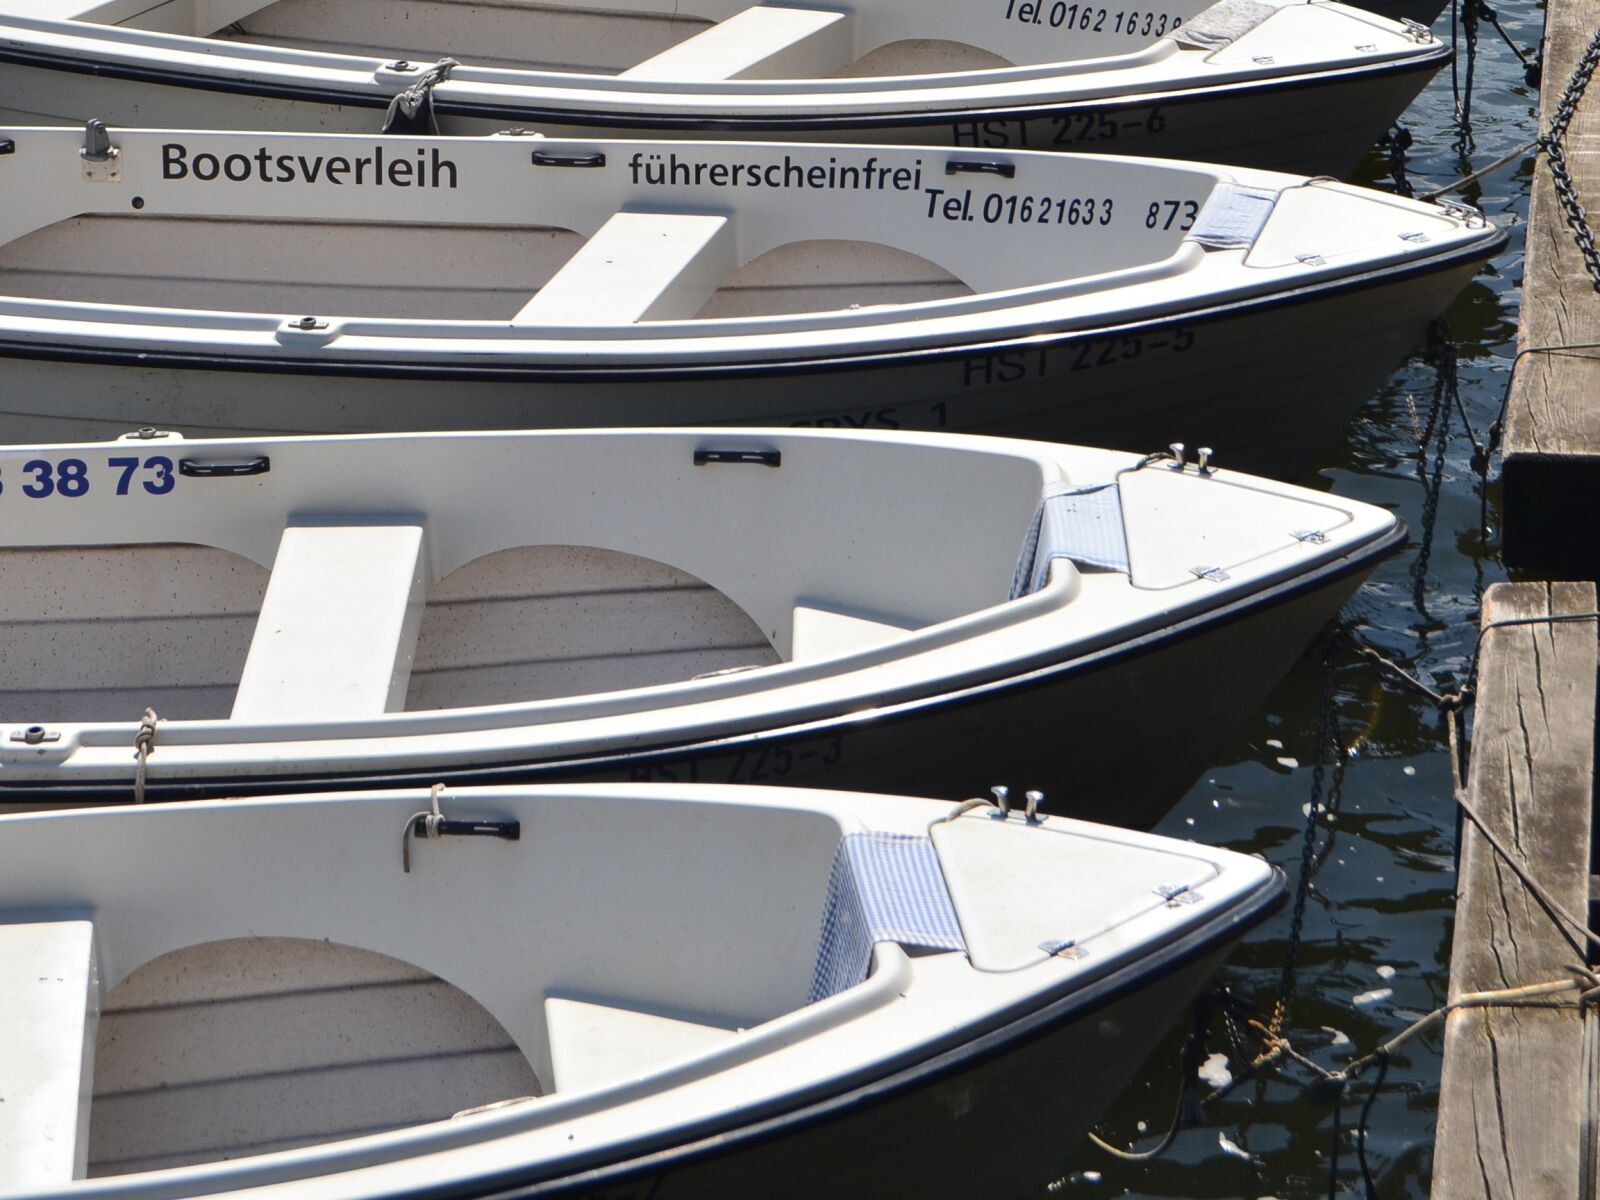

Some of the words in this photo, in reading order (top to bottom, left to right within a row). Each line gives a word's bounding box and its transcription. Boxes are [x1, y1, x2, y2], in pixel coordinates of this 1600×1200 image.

[952, 119, 1033, 148] HST
[1052, 106, 1167, 145] 225-6
[161, 142, 458, 189] Bootsverleih
[628, 152, 922, 191] führerscheinfrei
[924, 188, 974, 222] Tel.
[1145, 199, 1199, 232] 873
[964, 351, 1047, 386] HST
[1069, 327, 1195, 373] 225-5
[21, 458, 90, 499] 38
[107, 455, 176, 496] 73
